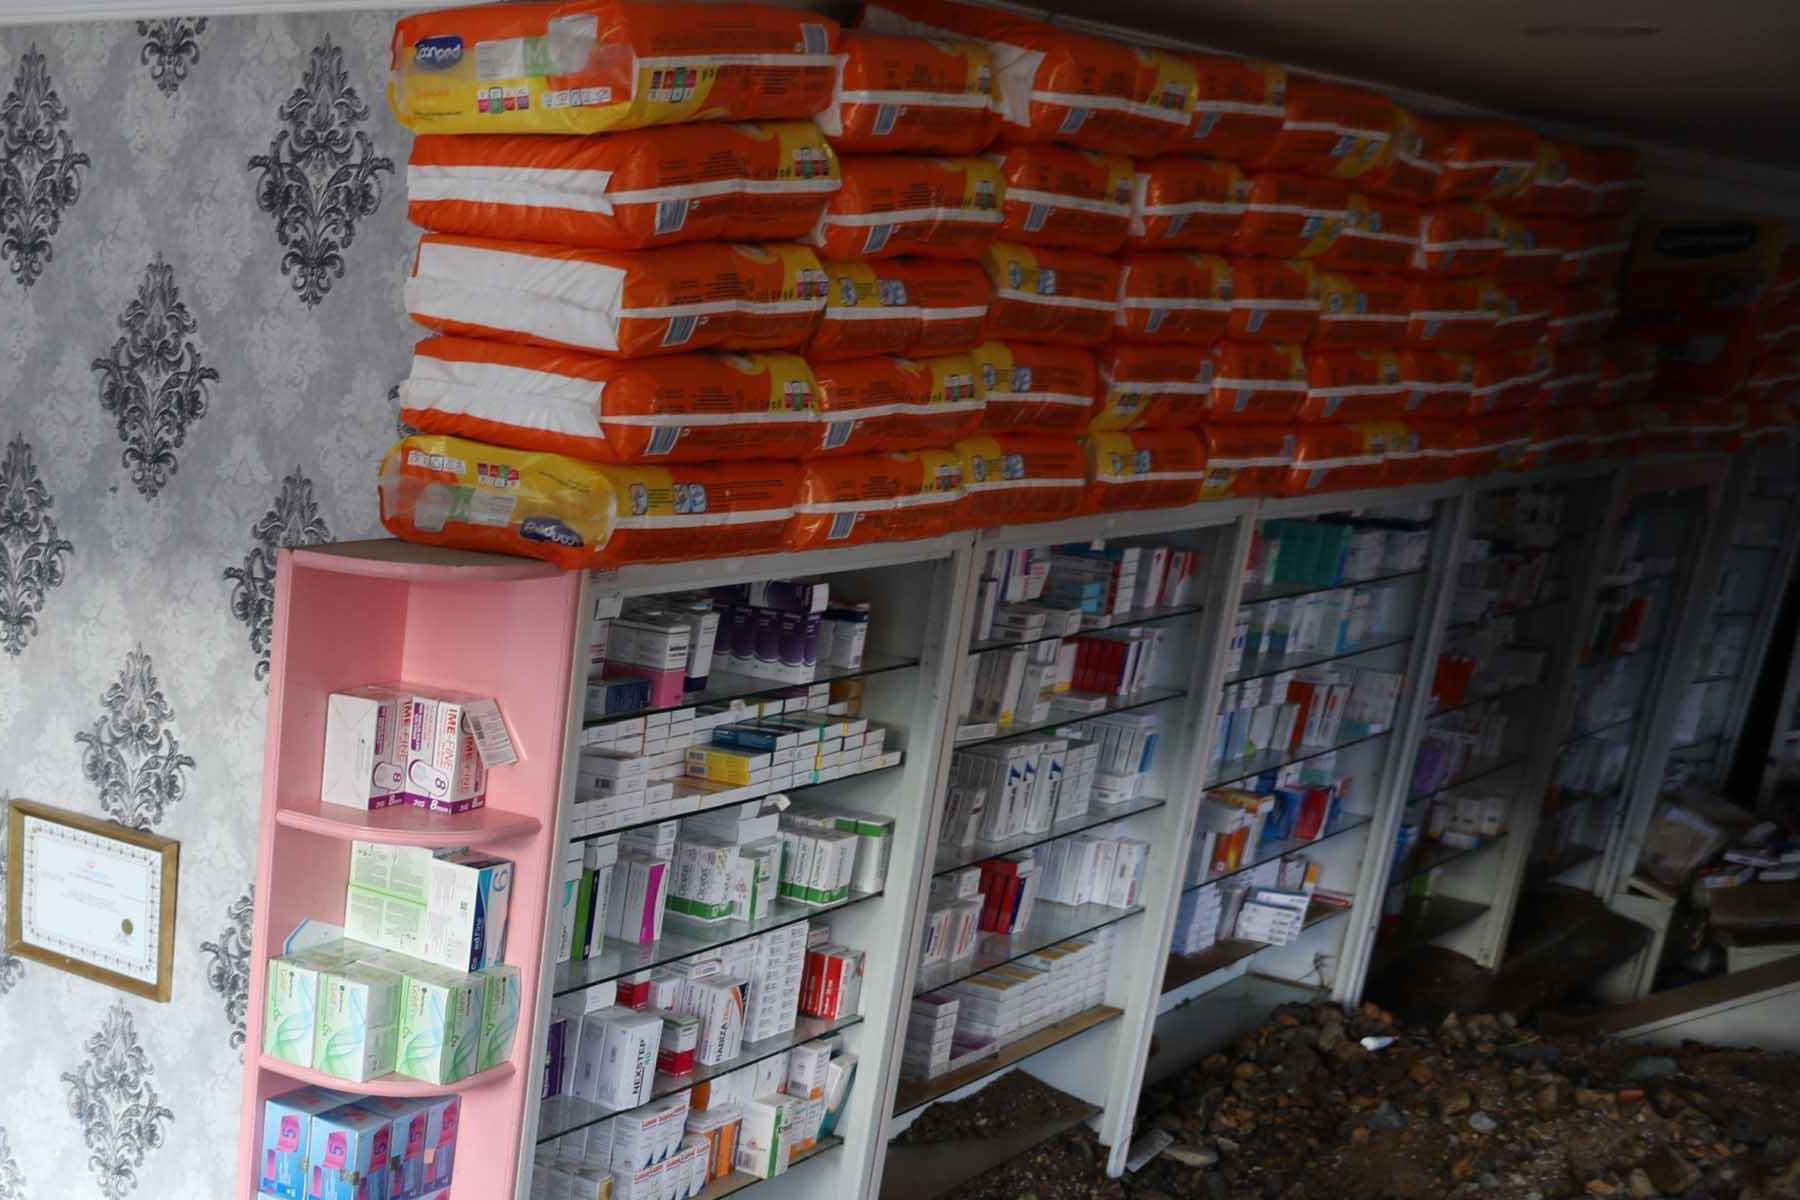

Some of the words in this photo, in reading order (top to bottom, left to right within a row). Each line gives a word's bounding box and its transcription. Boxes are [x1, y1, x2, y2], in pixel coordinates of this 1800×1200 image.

[417, 42, 462, 66] canped
[632, 1039, 647, 1096] NEXSTEP
[281, 1127, 297, 1139] 5
[328, 1145, 345, 1157] 5
